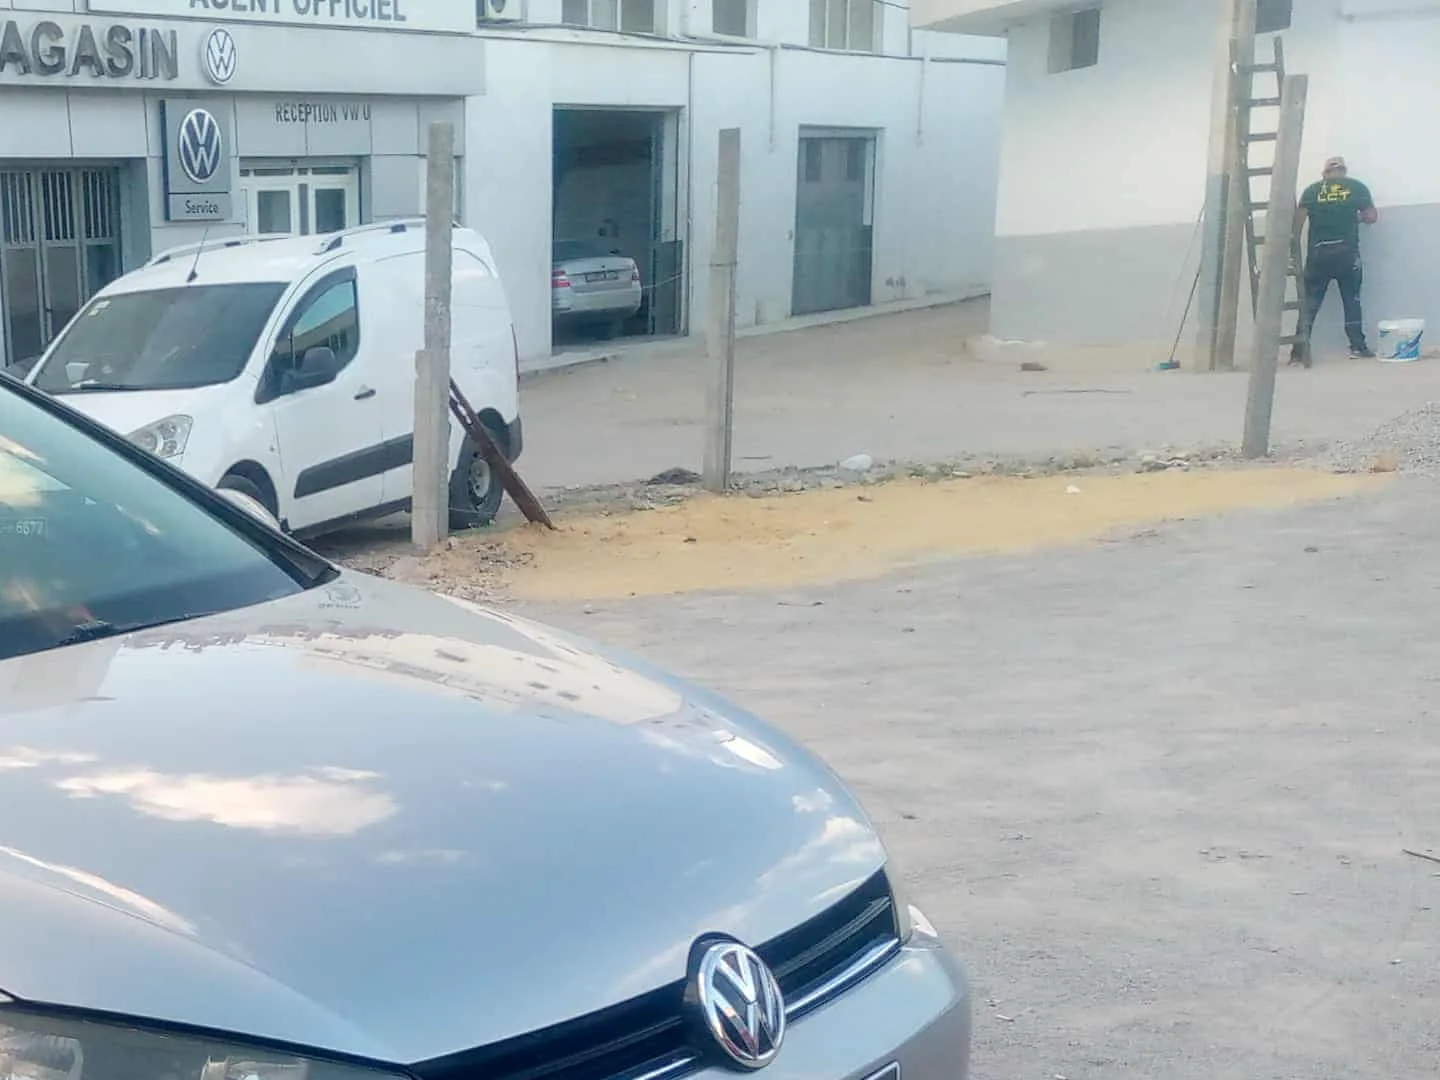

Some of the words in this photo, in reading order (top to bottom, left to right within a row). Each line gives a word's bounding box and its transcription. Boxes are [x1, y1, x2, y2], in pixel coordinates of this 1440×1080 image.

[275, 103, 337, 123] RECEPTION
[342, 104, 360, 121] VW
[184, 199, 218, 214] Service
